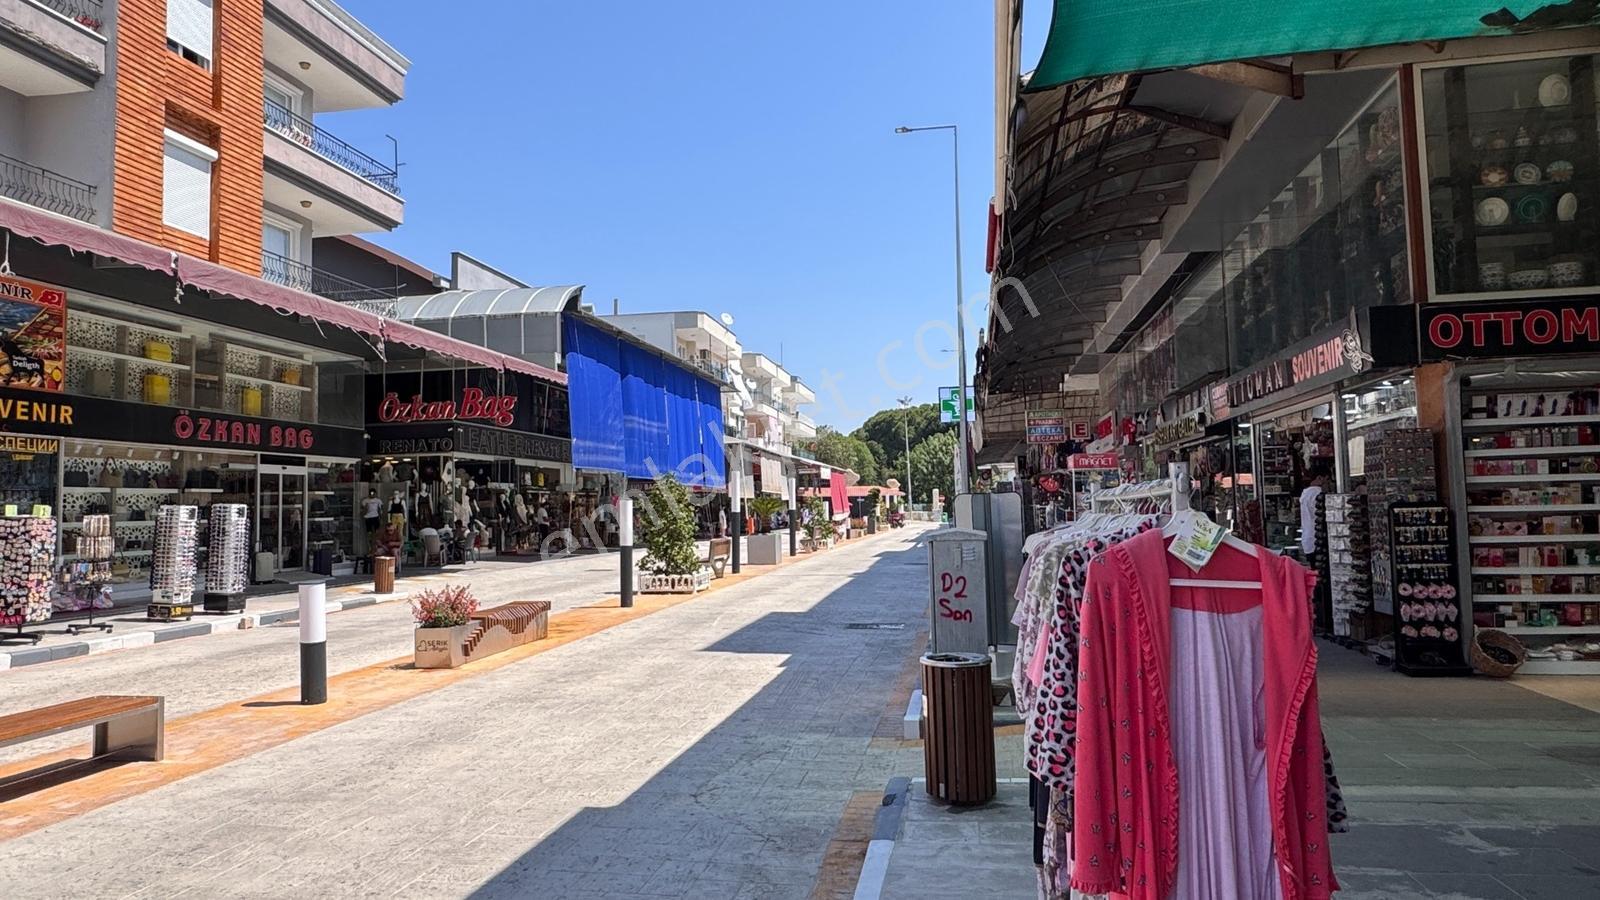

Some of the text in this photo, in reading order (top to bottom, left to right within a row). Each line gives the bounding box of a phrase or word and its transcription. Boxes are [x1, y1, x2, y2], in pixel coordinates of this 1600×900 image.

[1428, 307, 1599, 348] OTTOM
[1292, 336, 1344, 384] SOUVENIR
[0, 399, 73, 424] VENIR
[379, 387, 517, 427] Özkan Bag
[175, 410, 313, 449] ÖZKAN BAG
[379, 437, 453, 454] RENATO
[1075, 424, 1086, 436] E
